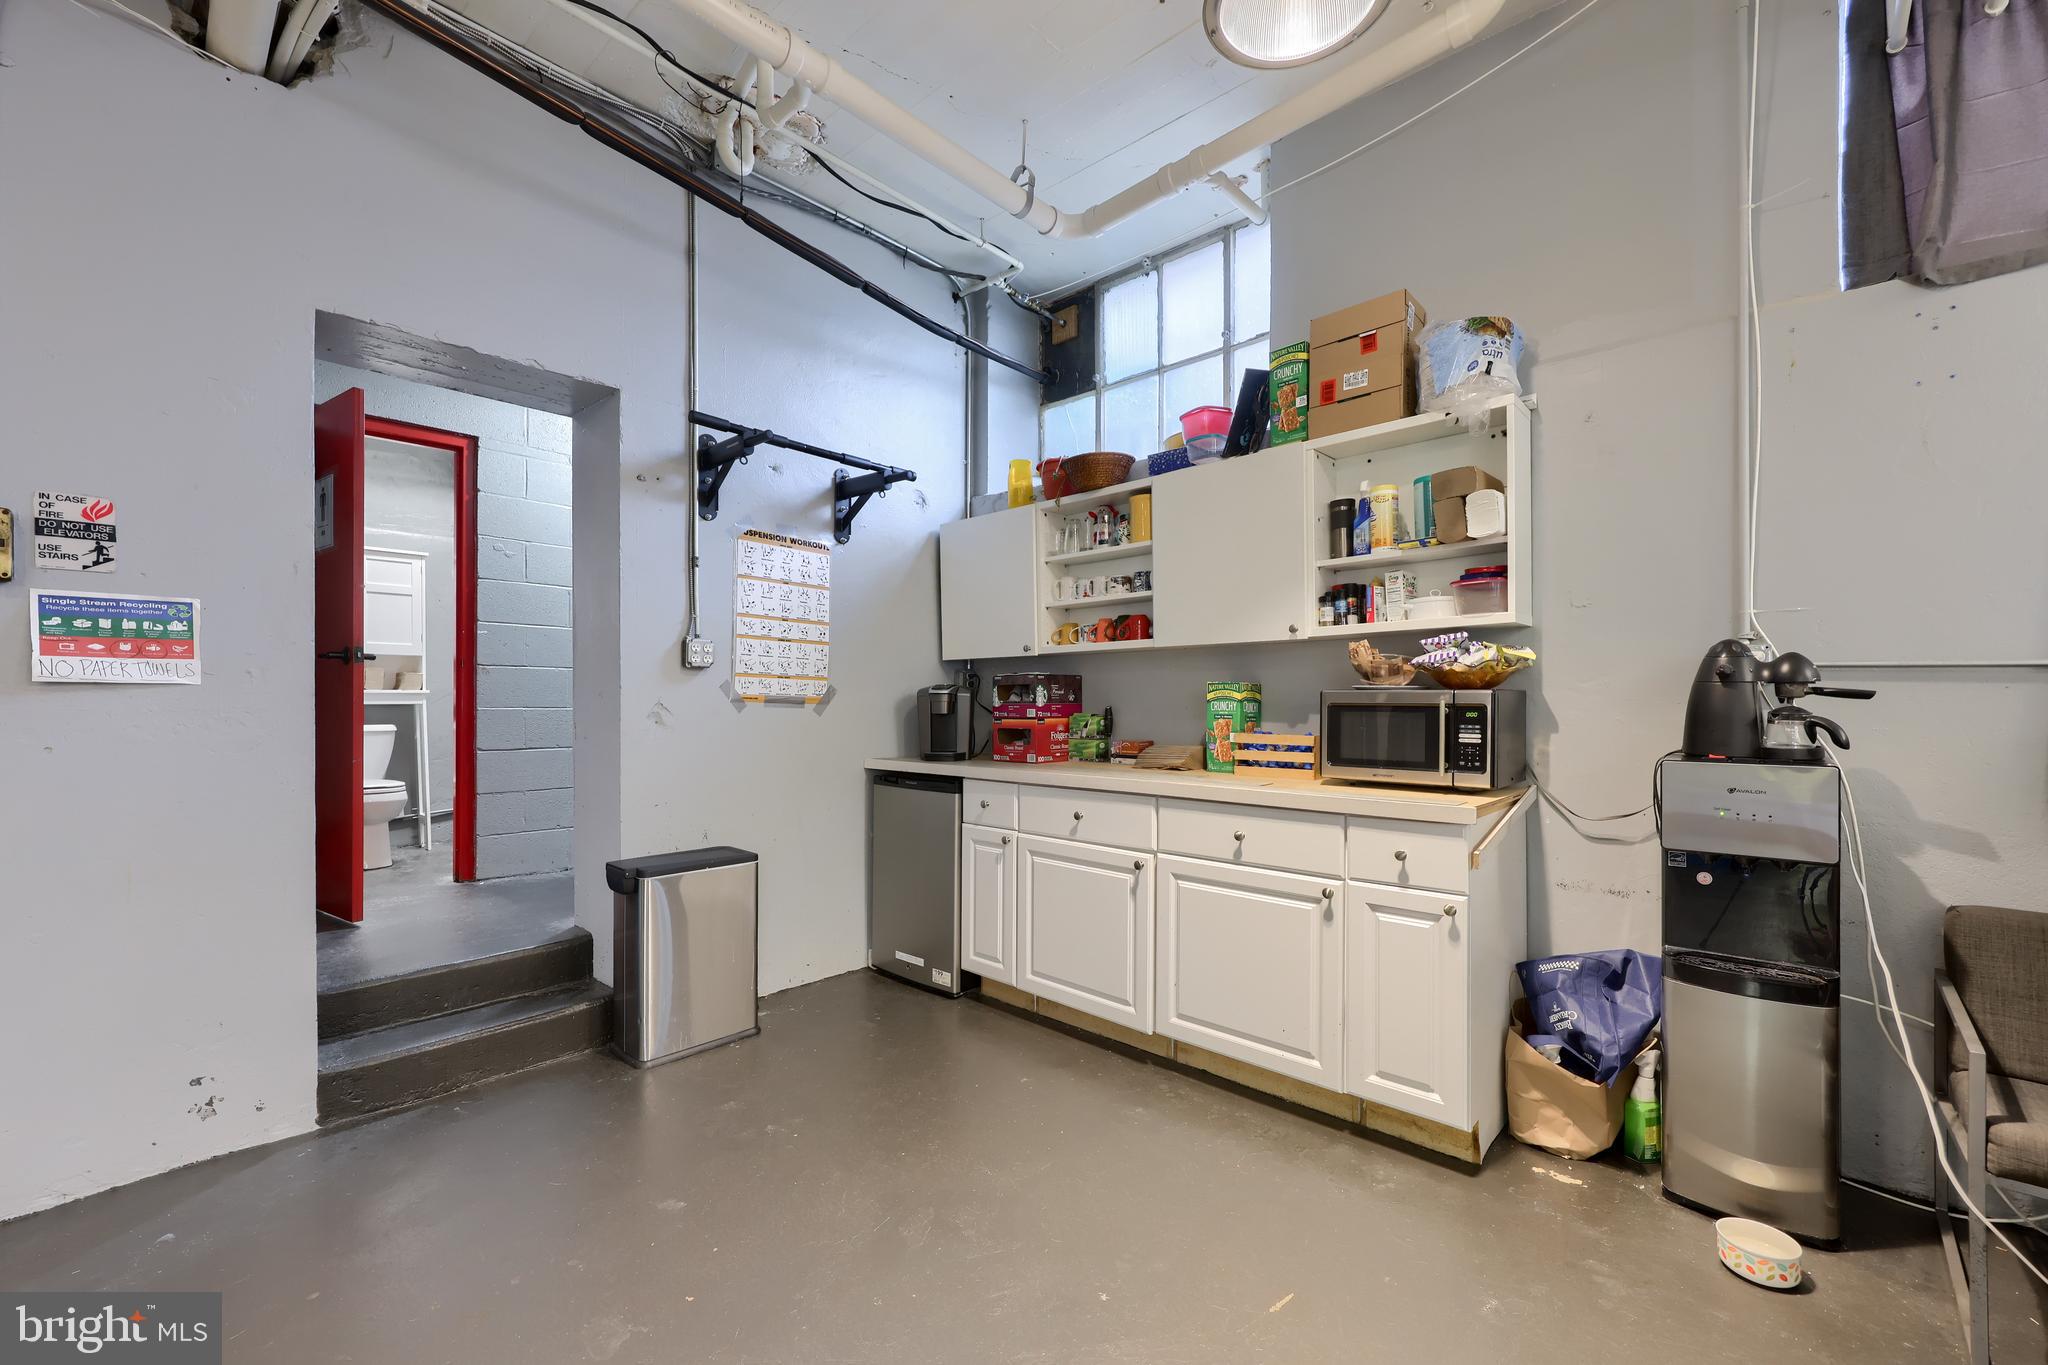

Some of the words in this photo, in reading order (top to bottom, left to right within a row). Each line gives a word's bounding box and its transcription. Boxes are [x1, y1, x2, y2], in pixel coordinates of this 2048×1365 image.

[1274, 362, 1302, 380] CRUNCHY
[38, 492, 50, 500] IN
[55, 494, 87, 504] CASE
[38, 510, 64, 519] FIRE
[62, 522, 86, 530] NOT
[91, 525, 113, 533] USE
[44, 528, 109, 540] ELEVATORS
[38, 543, 62, 552] USE
[38, 551, 79, 561] STAIRS
[41, 597, 76, 606] Single
[80, 599, 116, 607] Stream
[119, 601, 168, 610] Recycling
[46, 604, 80, 612] Recycle
[38, 658, 74, 677] NO
[79, 658, 132, 677] PAPER
[132, 660, 195, 679] TOWELS
[1210, 701, 1237, 711] CRUNCHY
